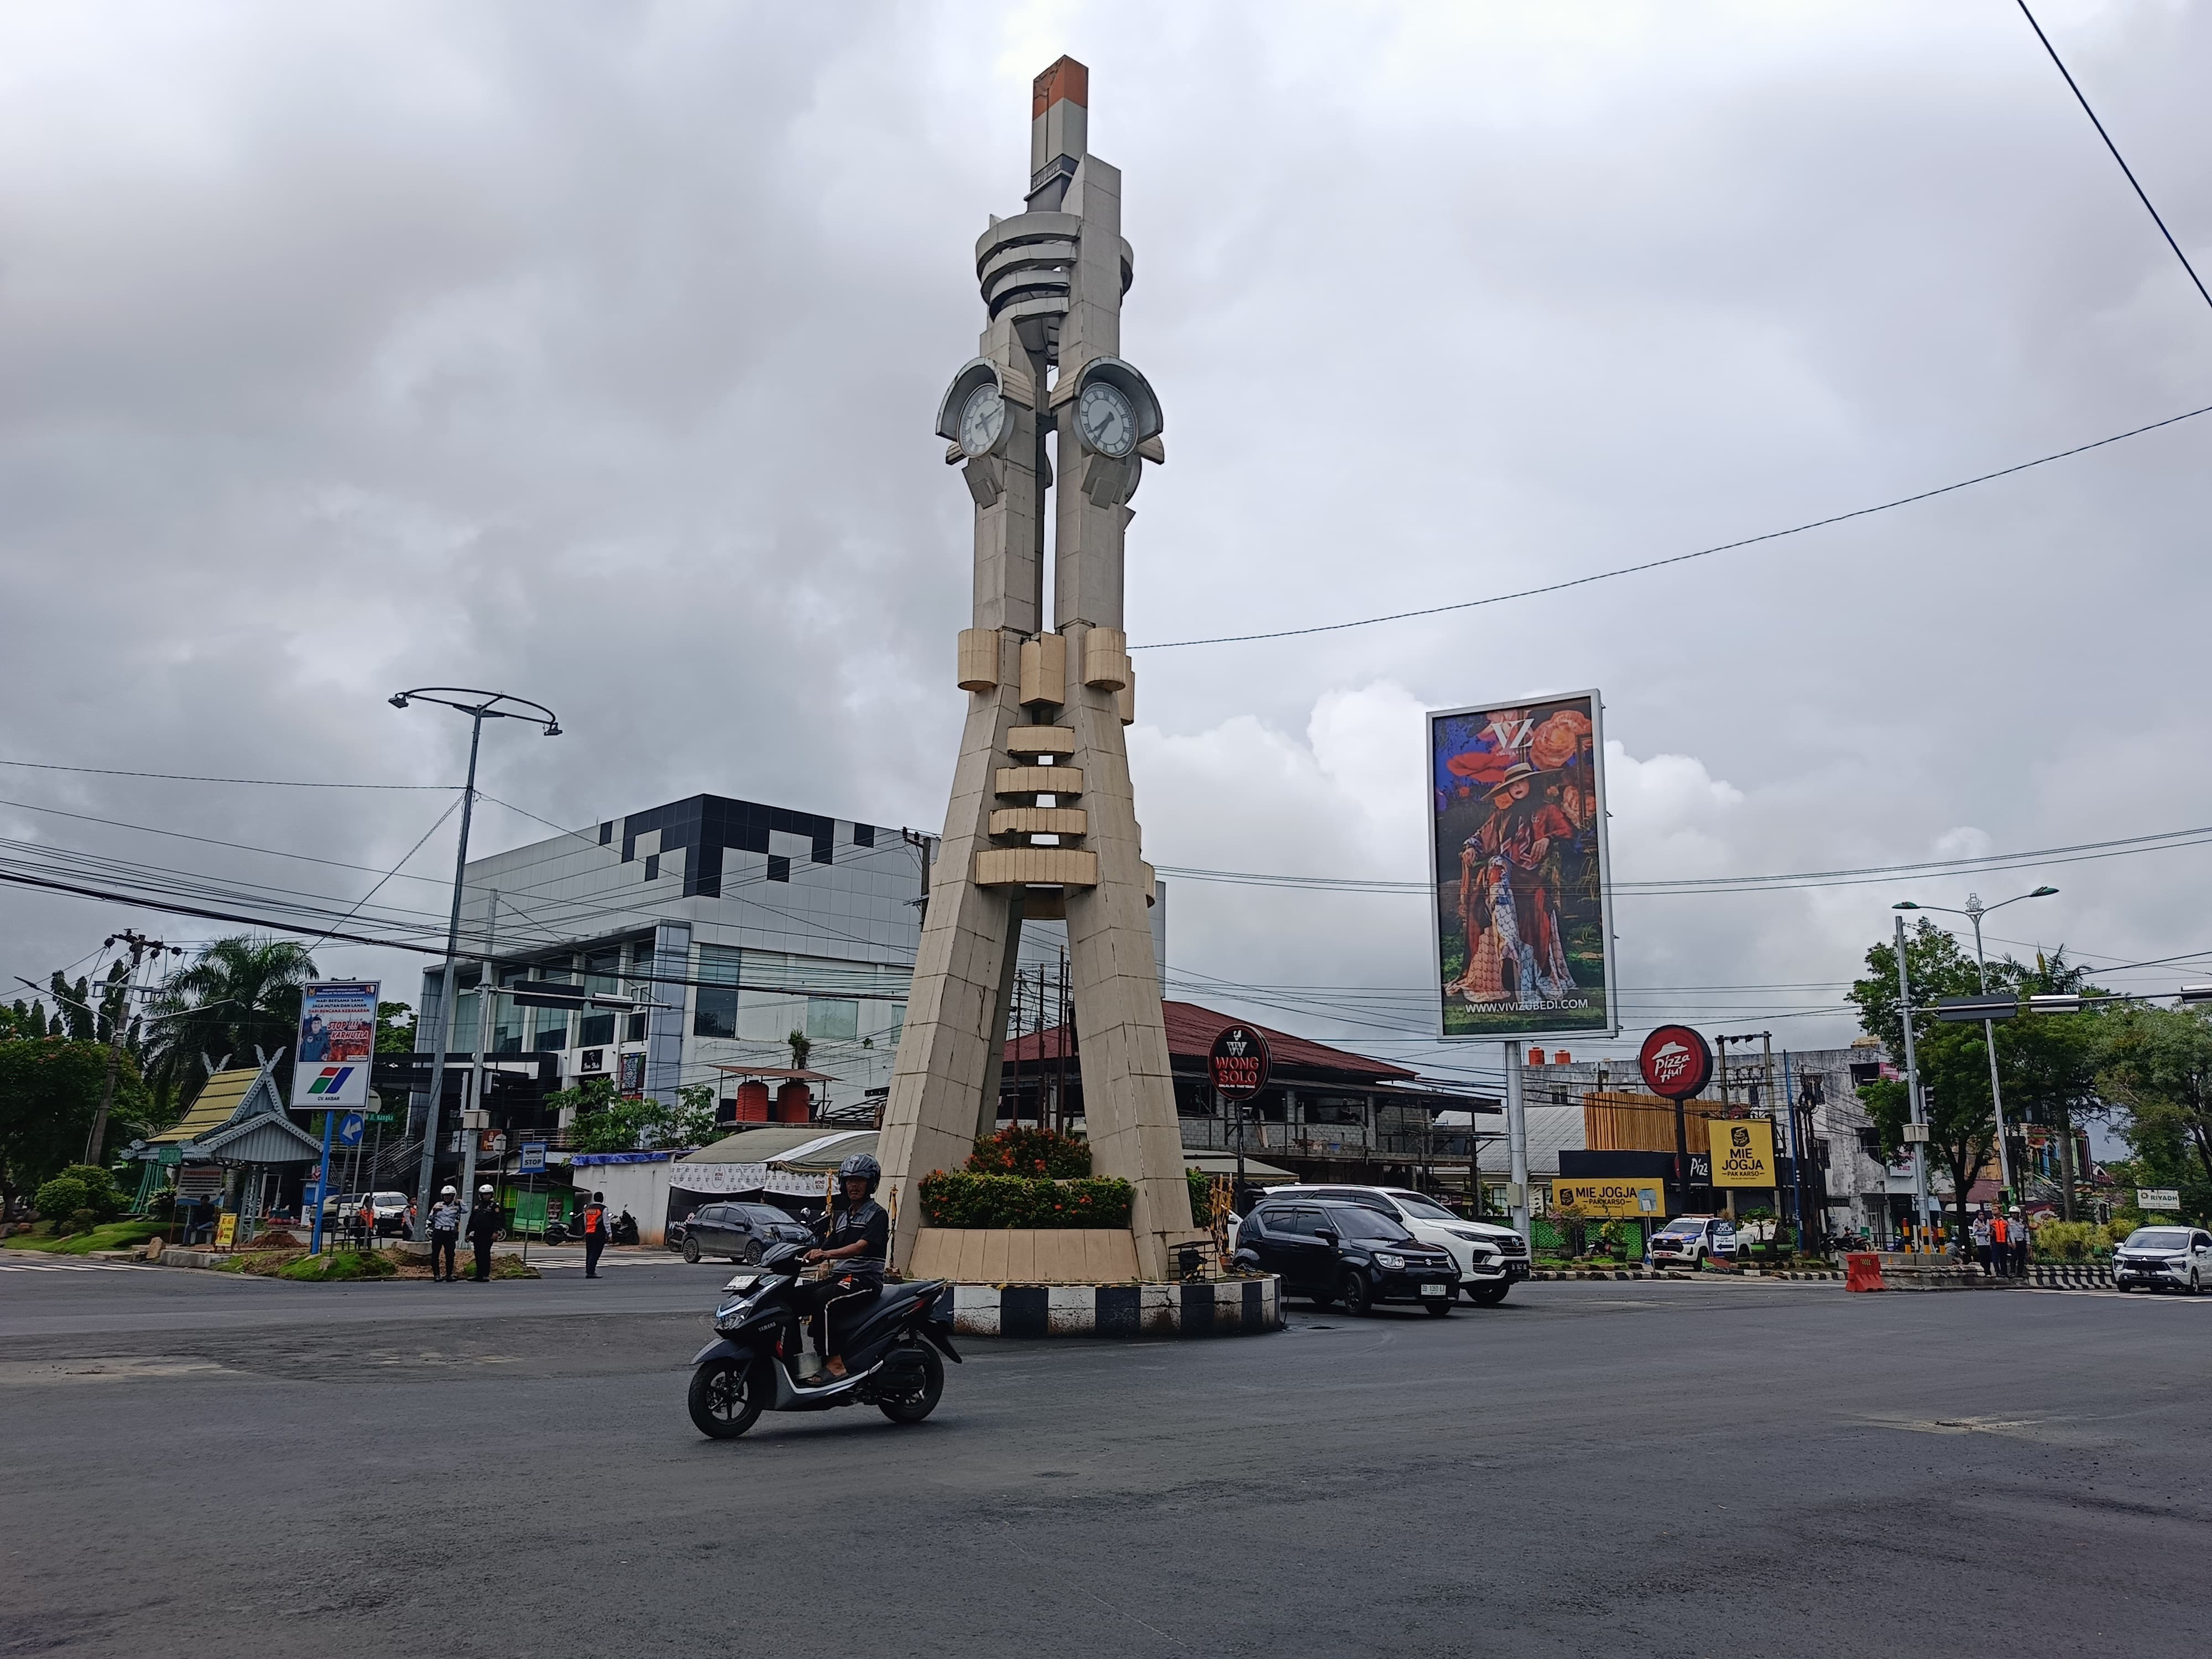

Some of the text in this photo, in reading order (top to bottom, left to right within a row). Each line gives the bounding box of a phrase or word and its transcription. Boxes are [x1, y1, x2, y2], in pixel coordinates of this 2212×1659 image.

[1465, 999, 1588, 1013] WWW.VIVIZUBEDI.COM
[327, 1021, 347, 1029] STOP
[331, 1031, 368, 1039] KARHUTLA
[1215, 1057, 1259, 1070] WONG
[1655, 1055, 1691, 1077] Pizza
[1219, 1071, 1257, 1084] SOLO
[1660, 1063, 1687, 1083] Hut
[1730, 1149, 1753, 1159] MIE
[1721, 1160, 1764, 1170] JOGJA
[1576, 1187, 1596, 1198] MIE
[1599, 1187, 1637, 1198] JOGJA
[758, 1322, 776, 1332] YAMAHA
